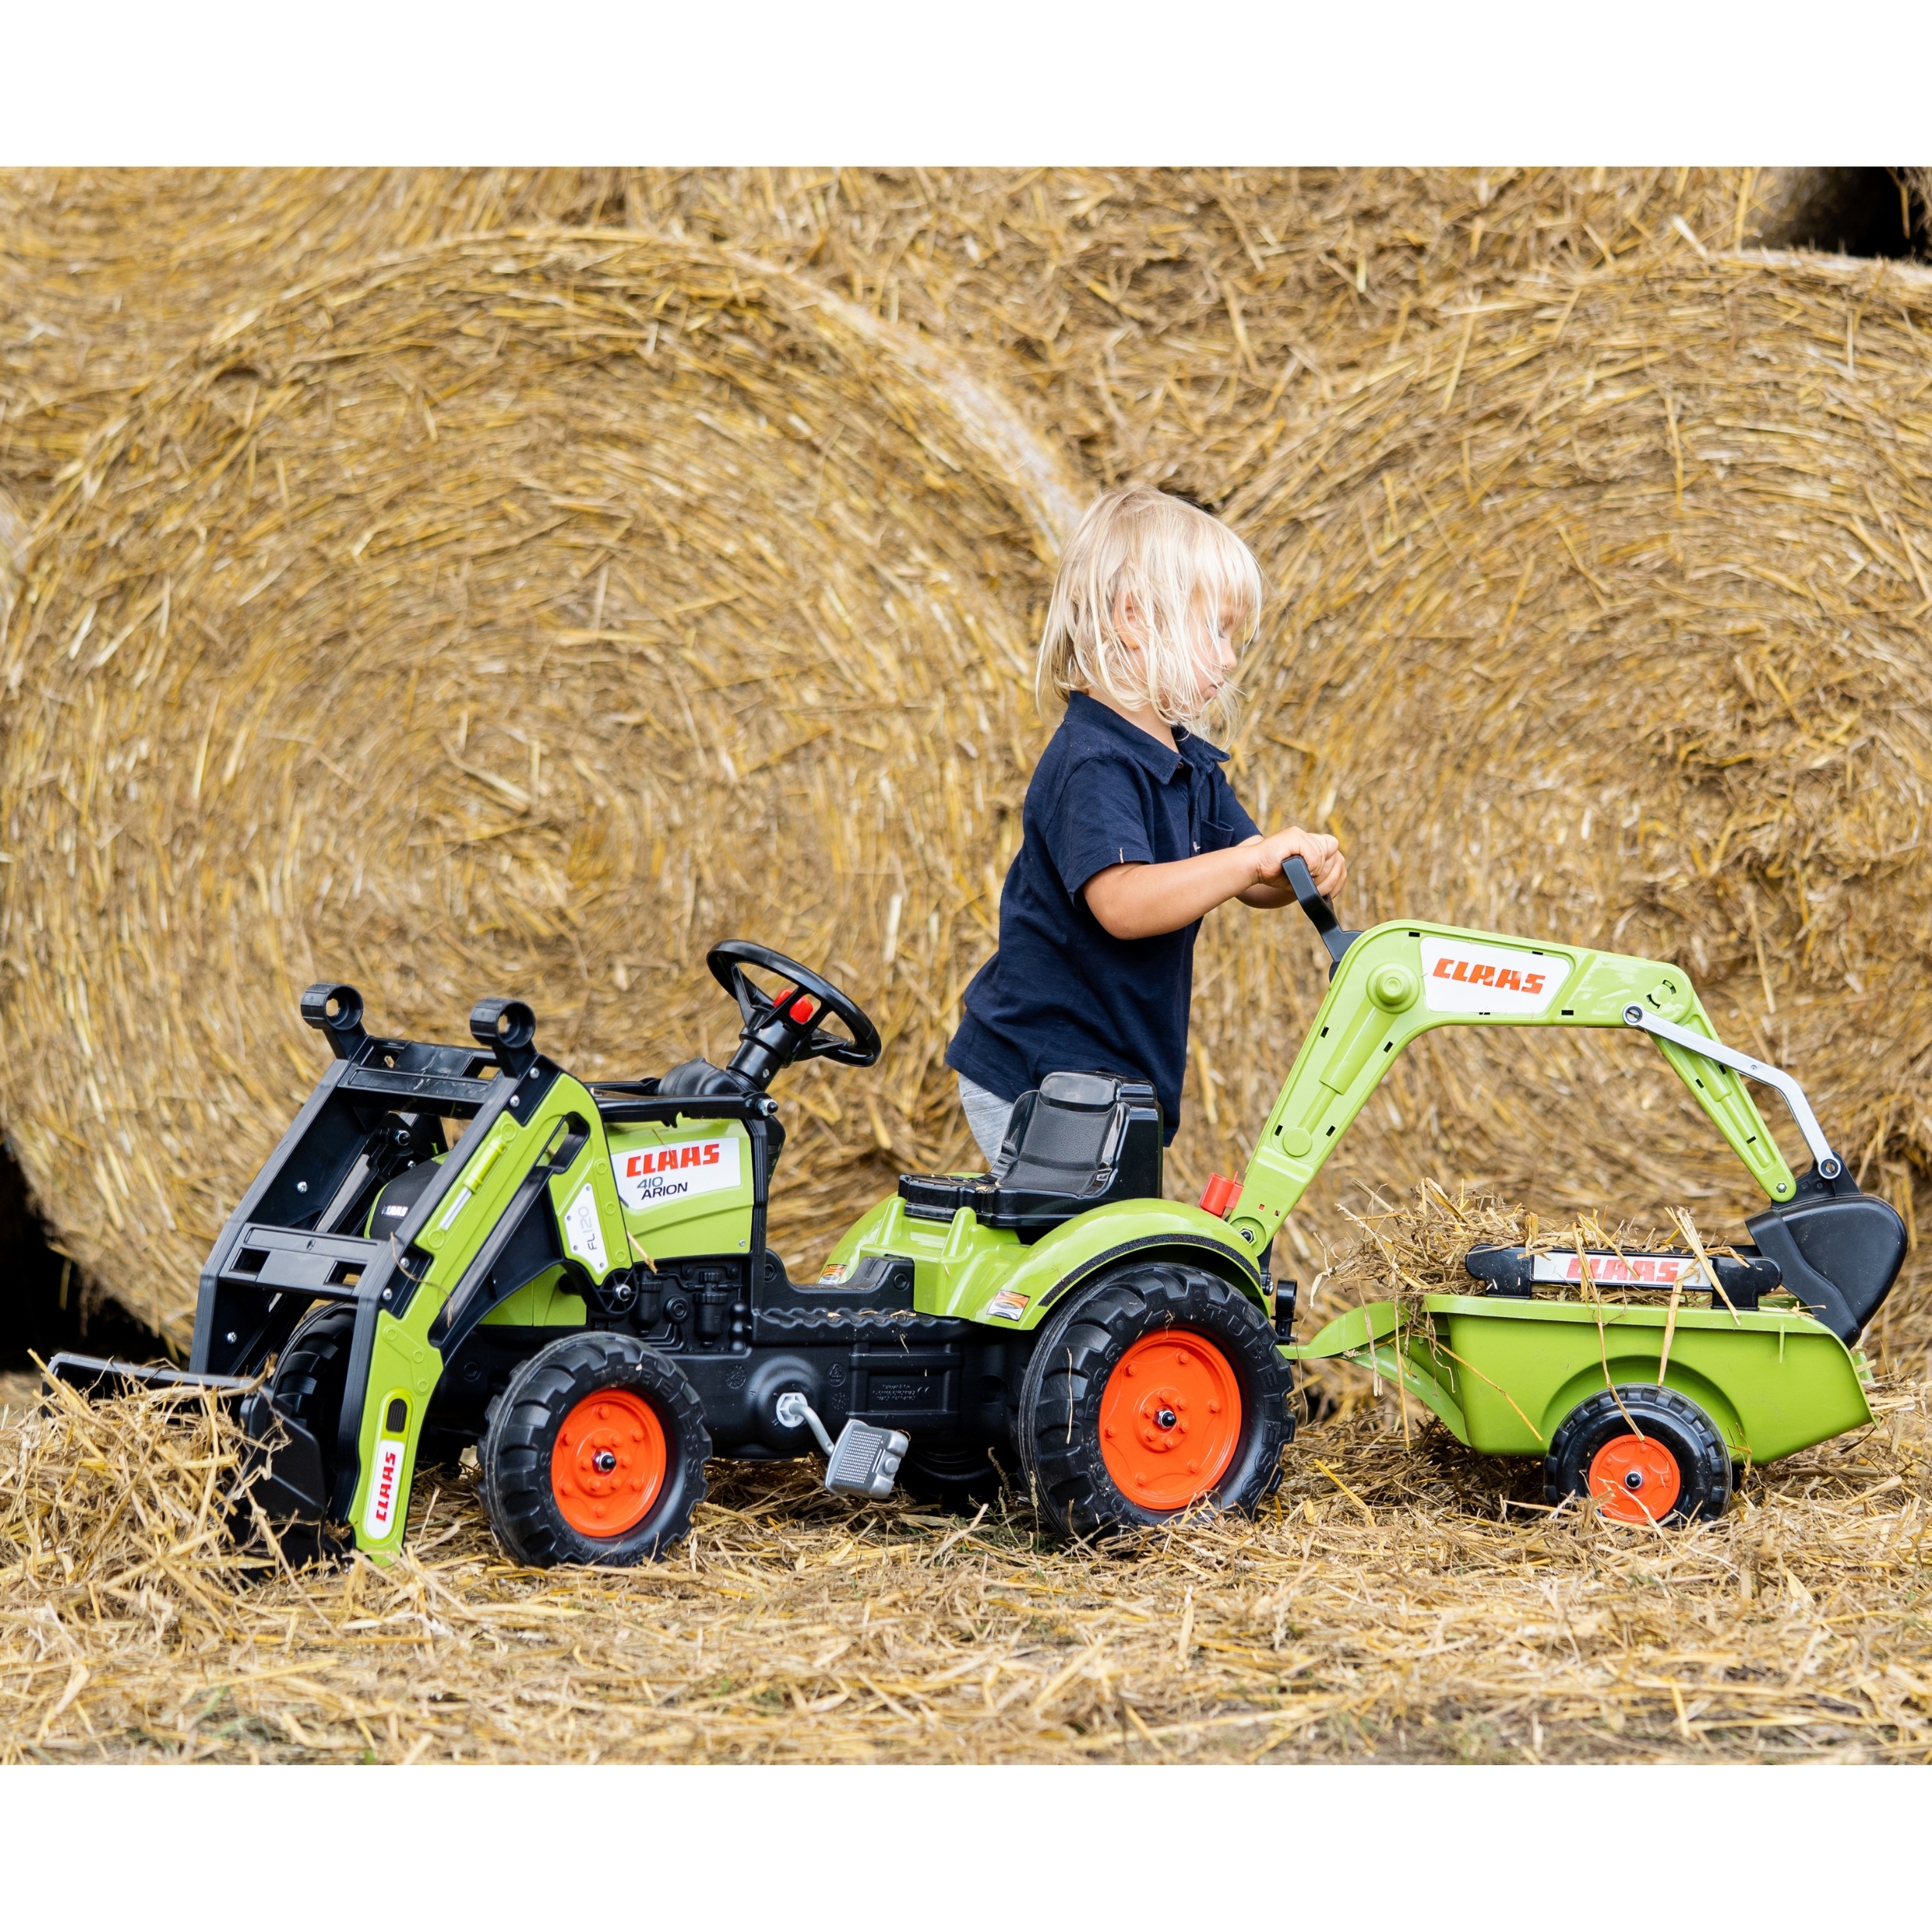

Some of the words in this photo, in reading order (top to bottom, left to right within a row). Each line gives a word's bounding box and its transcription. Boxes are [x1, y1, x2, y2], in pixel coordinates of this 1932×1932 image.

[1433, 957, 1546, 995] CLAAS
[627, 1144, 720, 1179] CLAAS
[637, 1176, 664, 1189] 410
[641, 1182, 688, 1200] ARION
[1566, 1257, 1679, 1283] CLAAS
[1206, 1303, 1281, 1499] TUBELESS
[594, 1366, 699, 1479] TUBELESS
[376, 1451, 397, 1523] CLAAS
